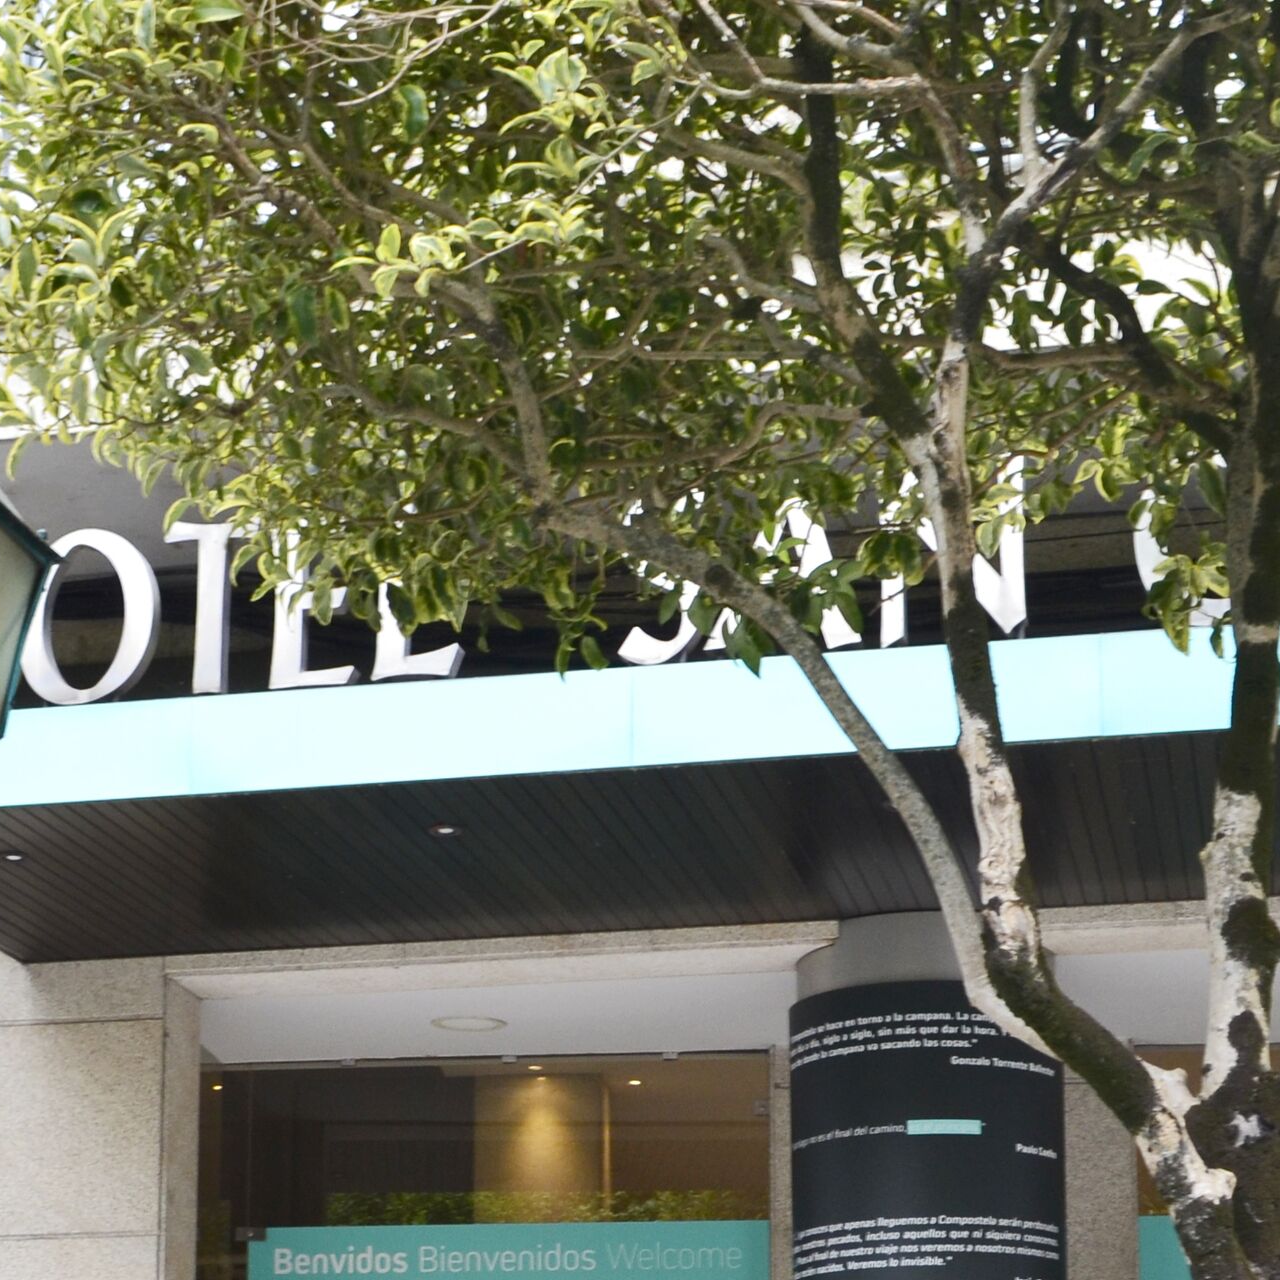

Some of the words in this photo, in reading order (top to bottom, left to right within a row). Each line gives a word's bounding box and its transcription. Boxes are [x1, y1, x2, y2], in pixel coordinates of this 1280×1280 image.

[20, 518, 465, 705] OTEL
[857, 1016, 884, 1025] torno
[905, 1012, 954, 1022] campana.
[956, 1011, 969, 1020] La
[877, 1027, 893, 1037] sin
[894, 1024, 917, 1035] más
[919, 1026, 939, 1035] que
[941, 1024, 959, 1034] dar
[961, 1024, 971, 1034] la
[974, 1025, 999, 1036] hora.
[880, 1038, 921, 1050] sacando
[923, 1038, 939, 1048] las
[950, 1056, 991, 1066] Gonzalo
[844, 1219, 876, 1231] apenas
[877, 1216, 928, 1228] lleguemos
[938, 1214, 997, 1226] Compostela
[865, 1231, 900, 1241] incluso
[903, 1228, 946, 1240] aquellos
[949, 1230, 970, 1239] que
[875, 1244, 899, 1255] viaje
[899, 1244, 919, 1253] nos
[920, 1244, 965, 1252] veremos
[974, 1244, 1016, 1254] nosotros
[274, 1247, 408, 1276] Benvidos
[419, 1244, 595, 1274] Bienvenidos
[605, 1242, 742, 1270] Welcome
[846, 1259, 888, 1270] Veremos
